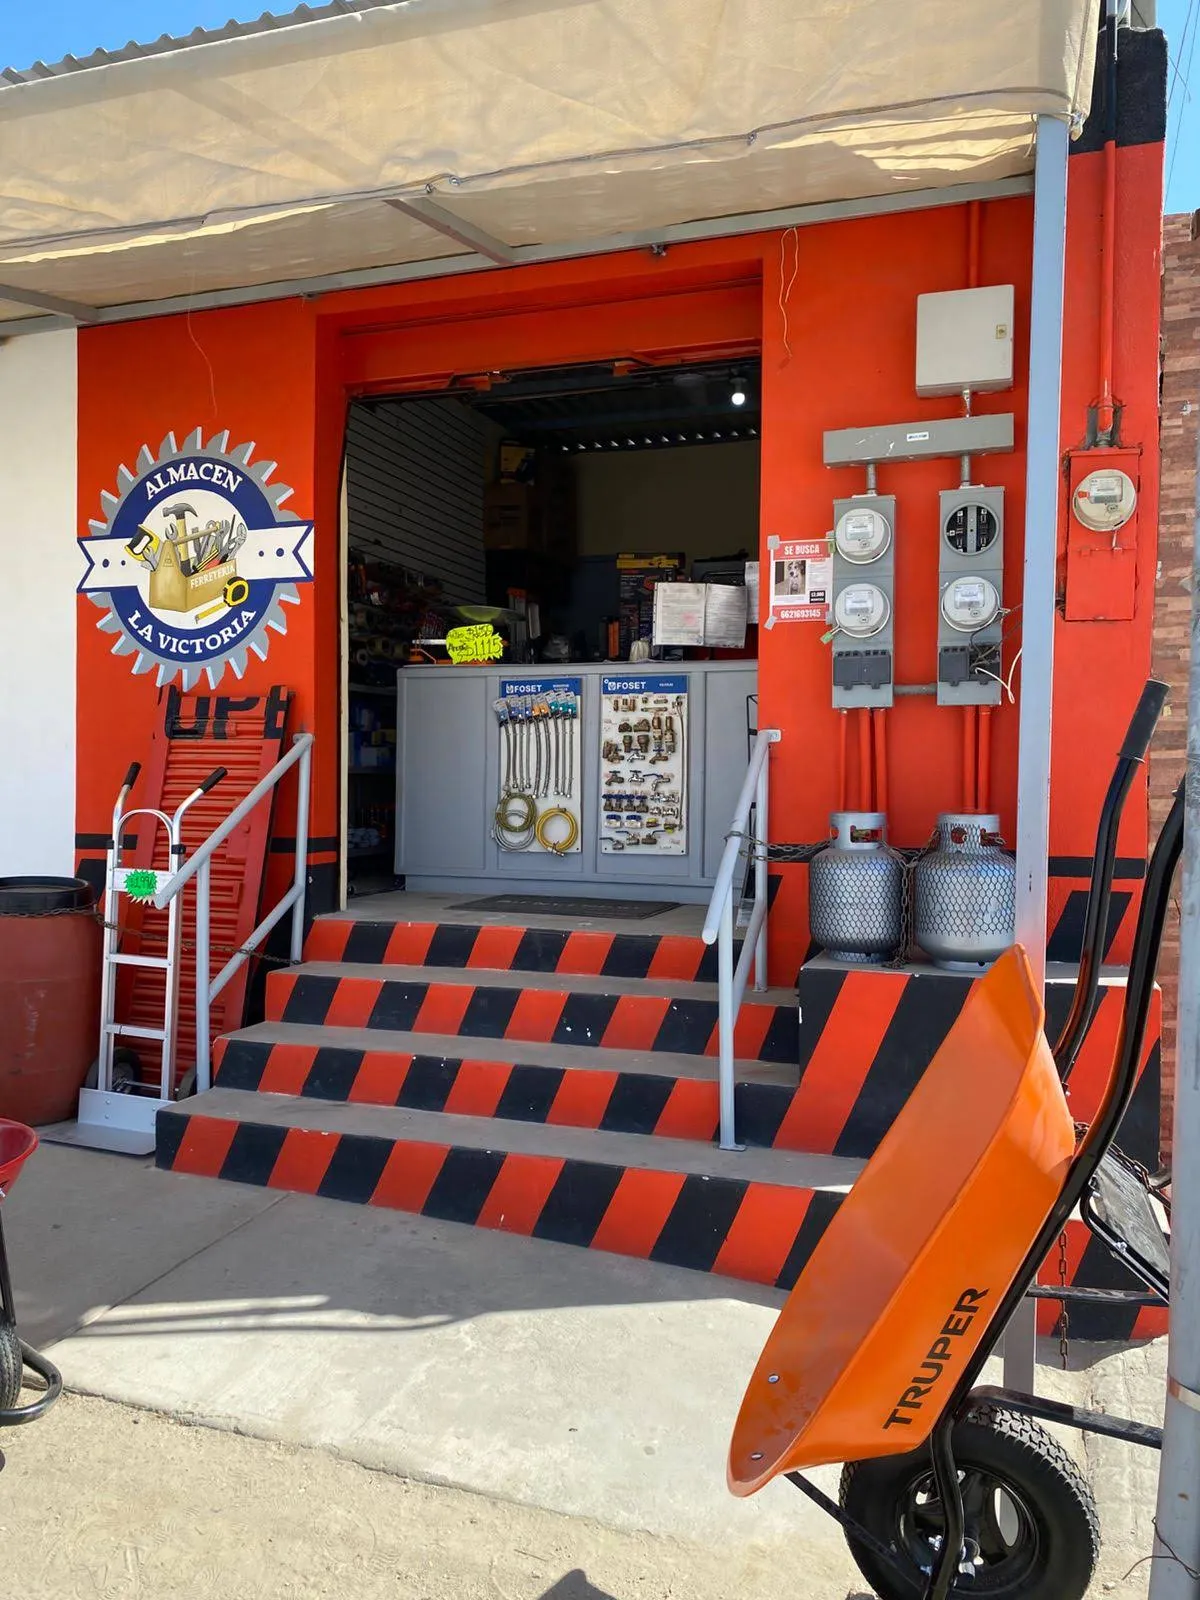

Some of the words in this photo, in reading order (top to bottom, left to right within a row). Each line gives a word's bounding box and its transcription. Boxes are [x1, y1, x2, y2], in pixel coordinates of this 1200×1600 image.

[145, 462, 243, 500] ALMACEN
[784, 545, 794, 555] SE
[795, 544, 820, 554] BUSCA
[127, 610, 153, 643] LA
[158, 608, 257, 655] VICTORIA
[514, 684, 543, 693] FOSET
[616, 681, 647, 690] FOSET
[881, 1288, 990, 1430] TRUPER
